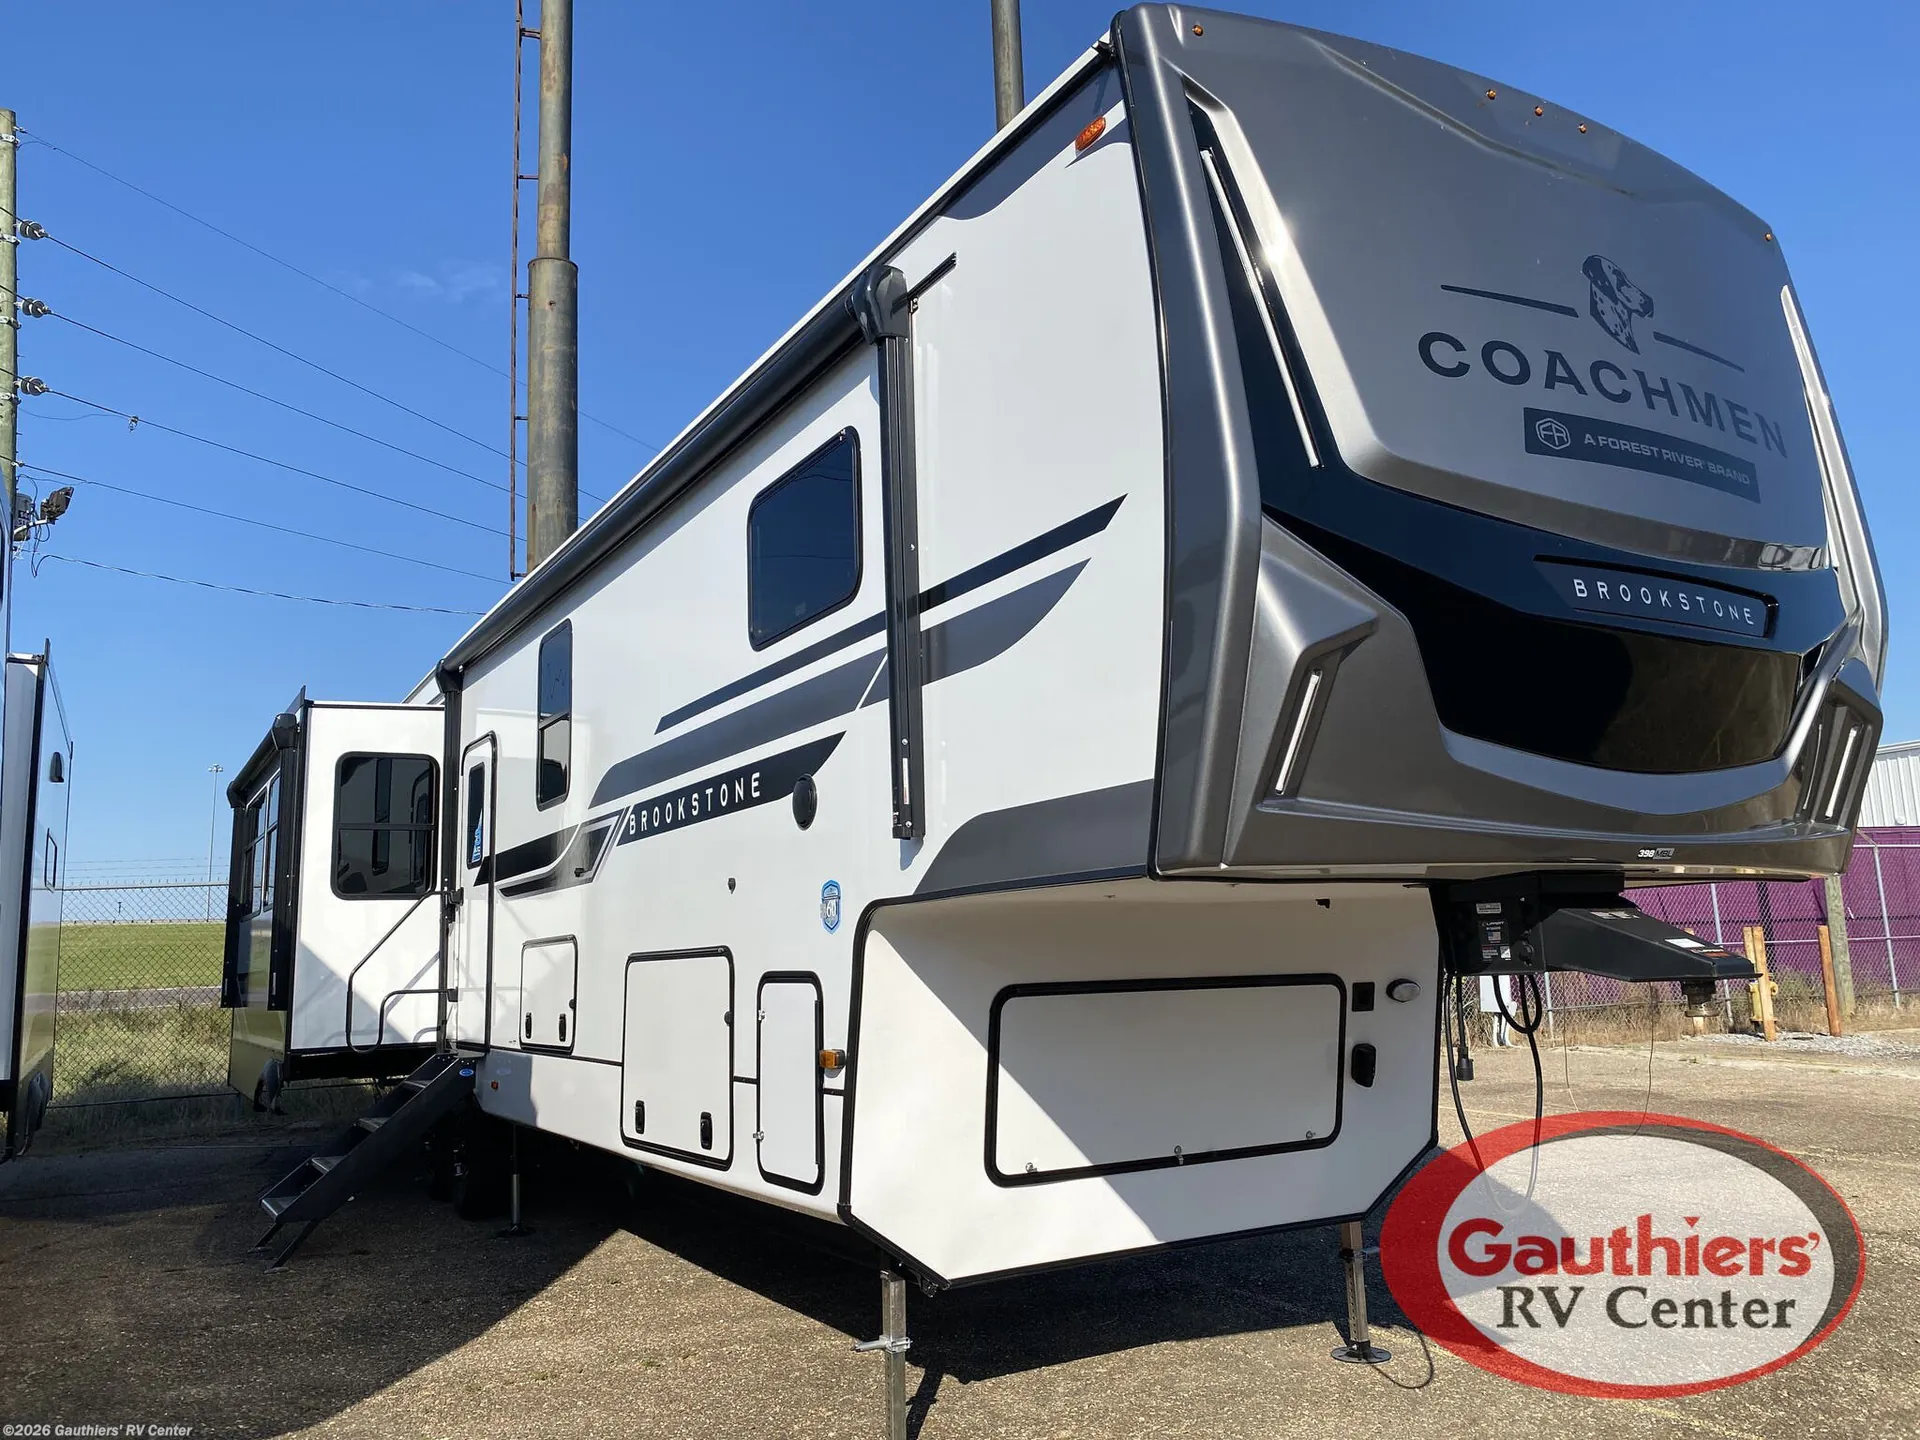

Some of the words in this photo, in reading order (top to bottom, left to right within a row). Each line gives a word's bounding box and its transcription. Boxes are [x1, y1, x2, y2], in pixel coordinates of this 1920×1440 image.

[1418, 331, 1788, 459] COACHMEN
[1584, 433, 1596, 446] A
[1599, 435, 1660, 458] FOREST
[1707, 461, 1750, 485] BRAND
[1573, 578, 1755, 625] BROOKSTONE
[629, 772, 760, 835] BROOKSTONE
